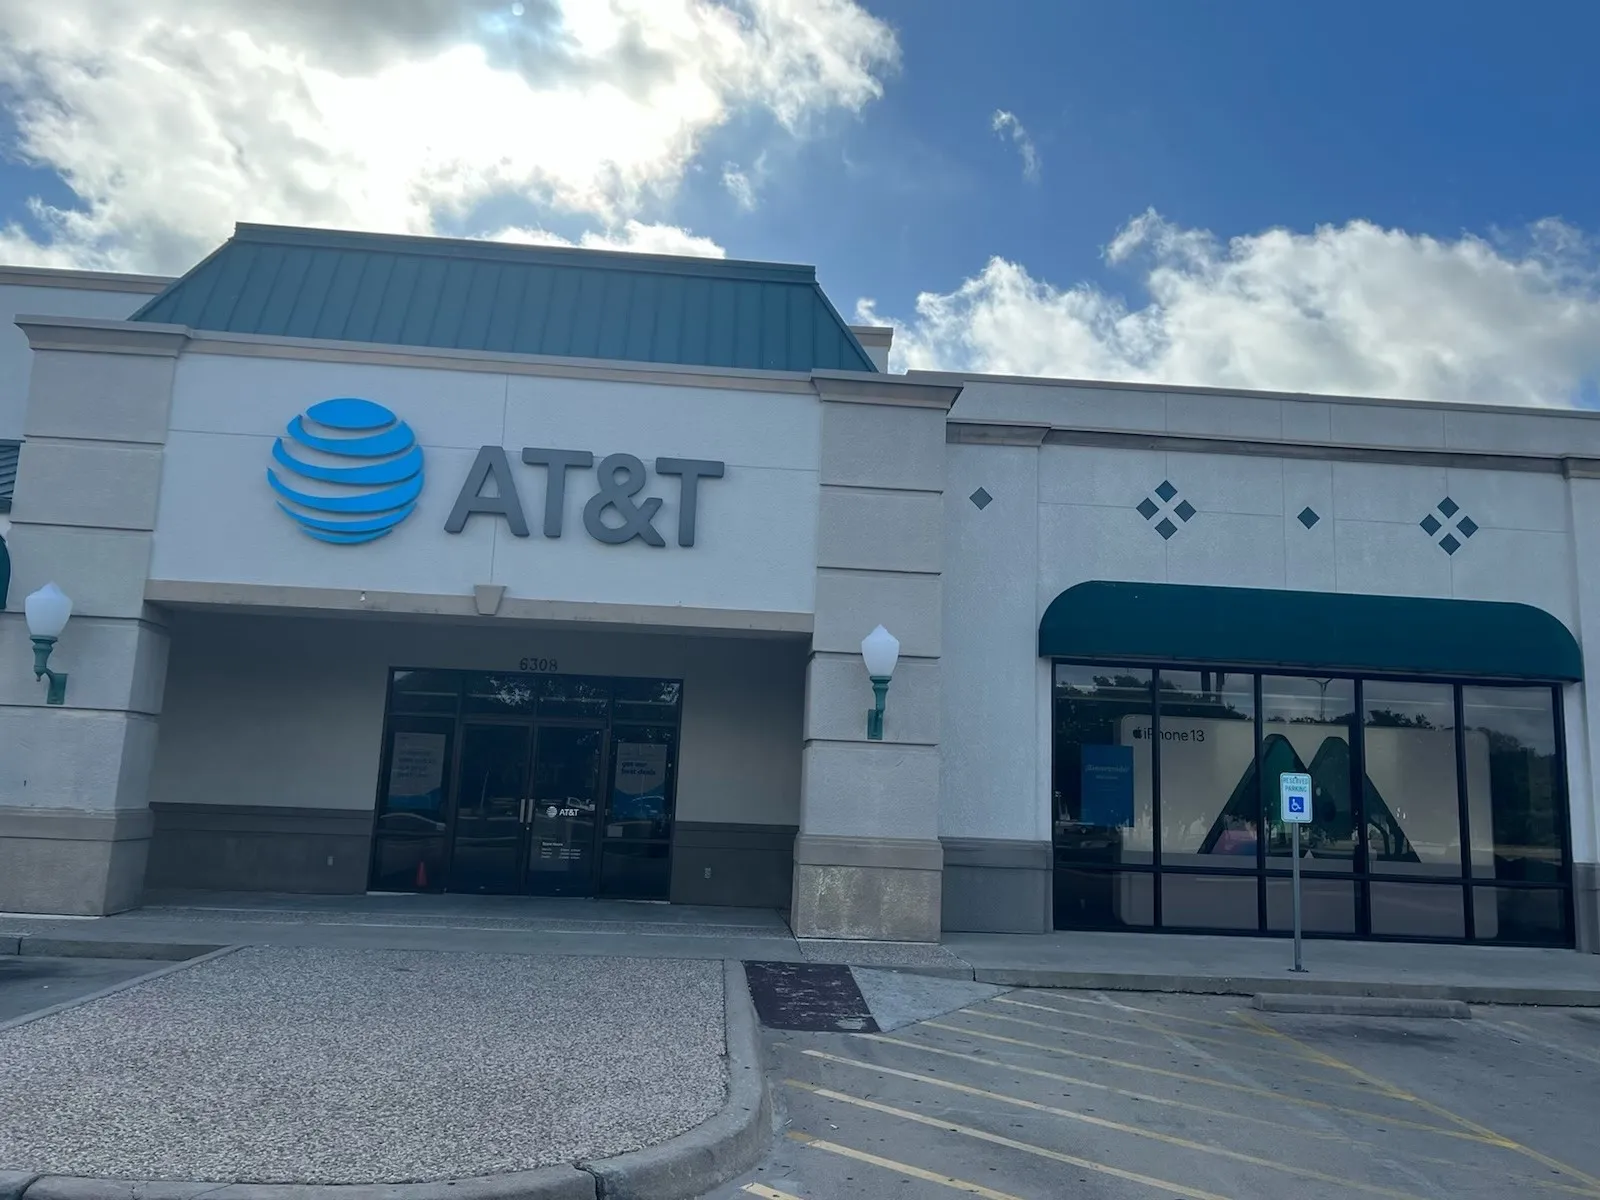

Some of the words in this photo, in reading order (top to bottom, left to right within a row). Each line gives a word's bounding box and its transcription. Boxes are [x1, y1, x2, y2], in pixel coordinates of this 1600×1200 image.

[444, 446, 725, 548] AT&T
[520, 657, 558, 672] 6308
[1190, 729, 1205, 743] 13
[1283, 777, 1309, 785] RESERVED
[558, 808, 580, 817] AT&T
